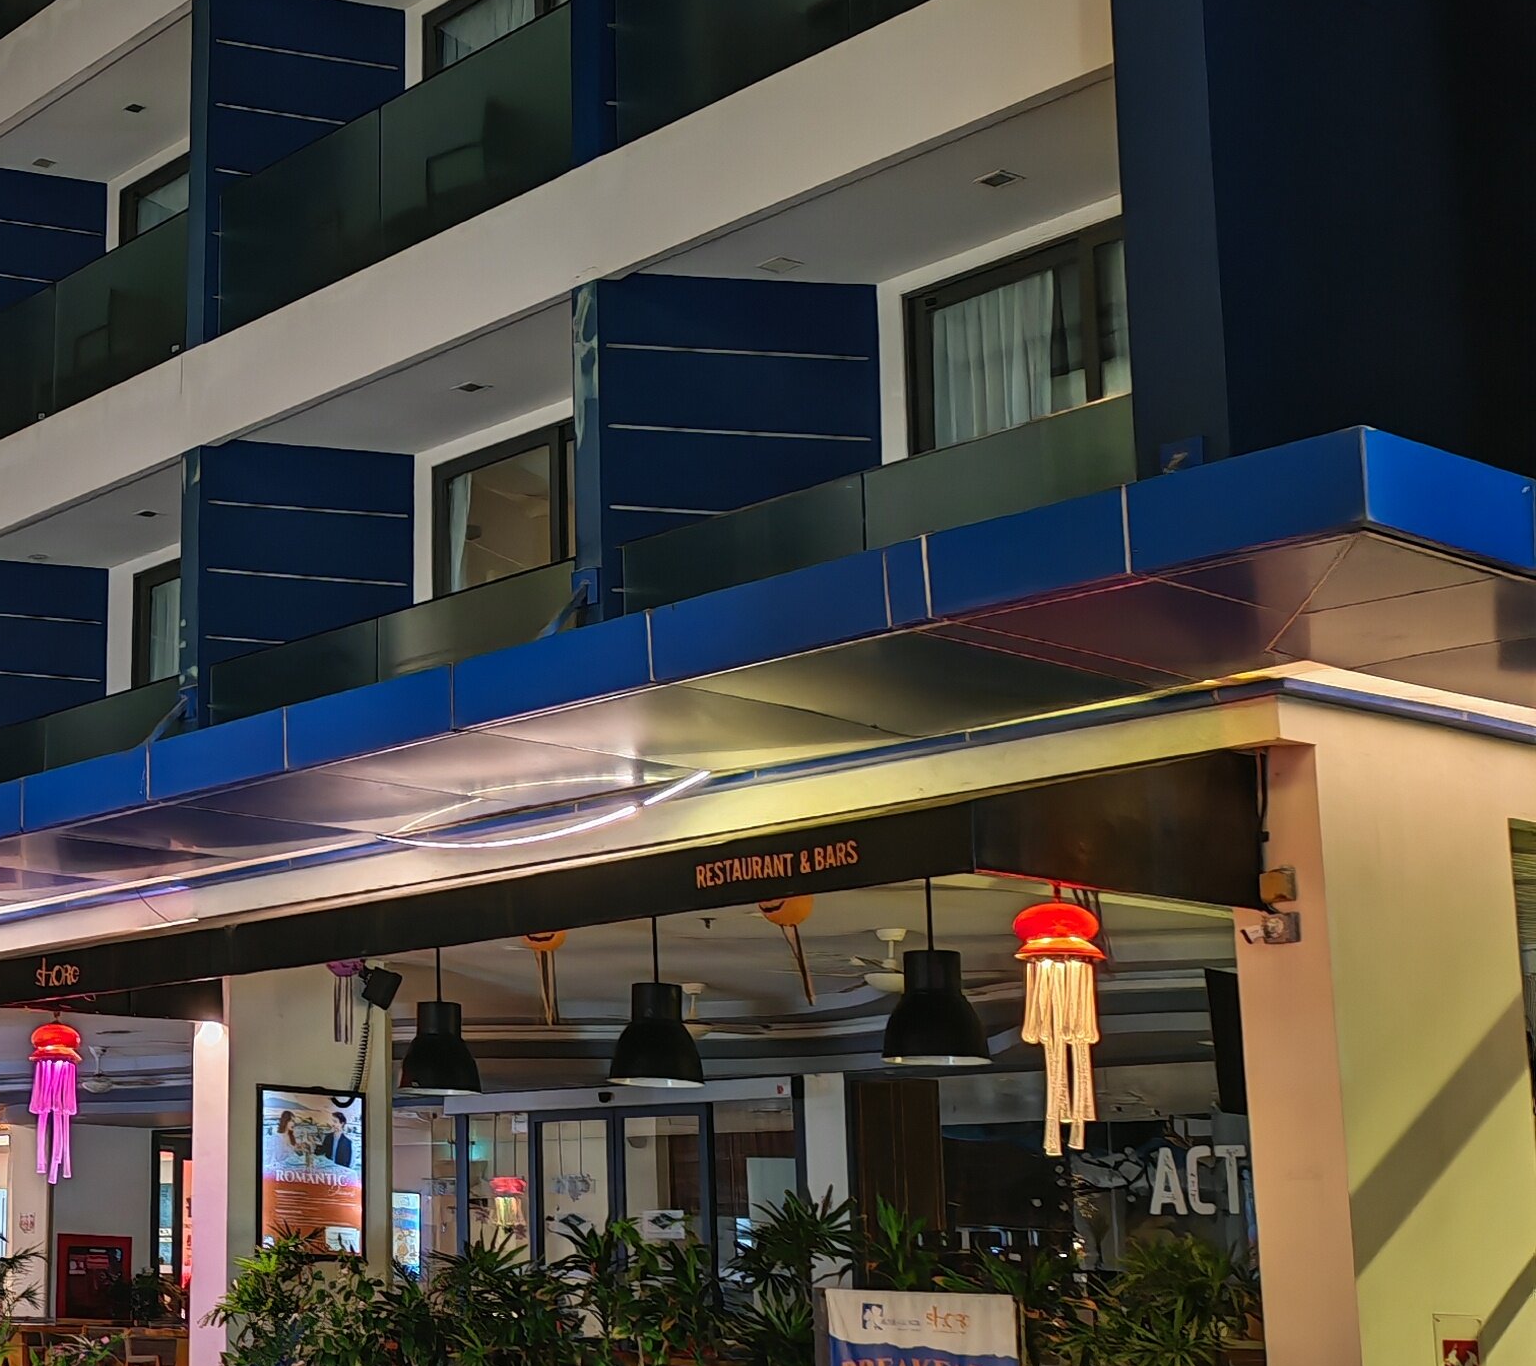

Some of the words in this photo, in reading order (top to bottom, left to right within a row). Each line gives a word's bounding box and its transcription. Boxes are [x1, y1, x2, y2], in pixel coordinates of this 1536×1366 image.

[695, 853, 794, 889] RESTAURANT
[799, 850, 812, 874] &
[814, 840, 859, 871] BARS
[275, 1169, 349, 1187] ROMANTIC
[1149, 1144, 1247, 1215] ACT
